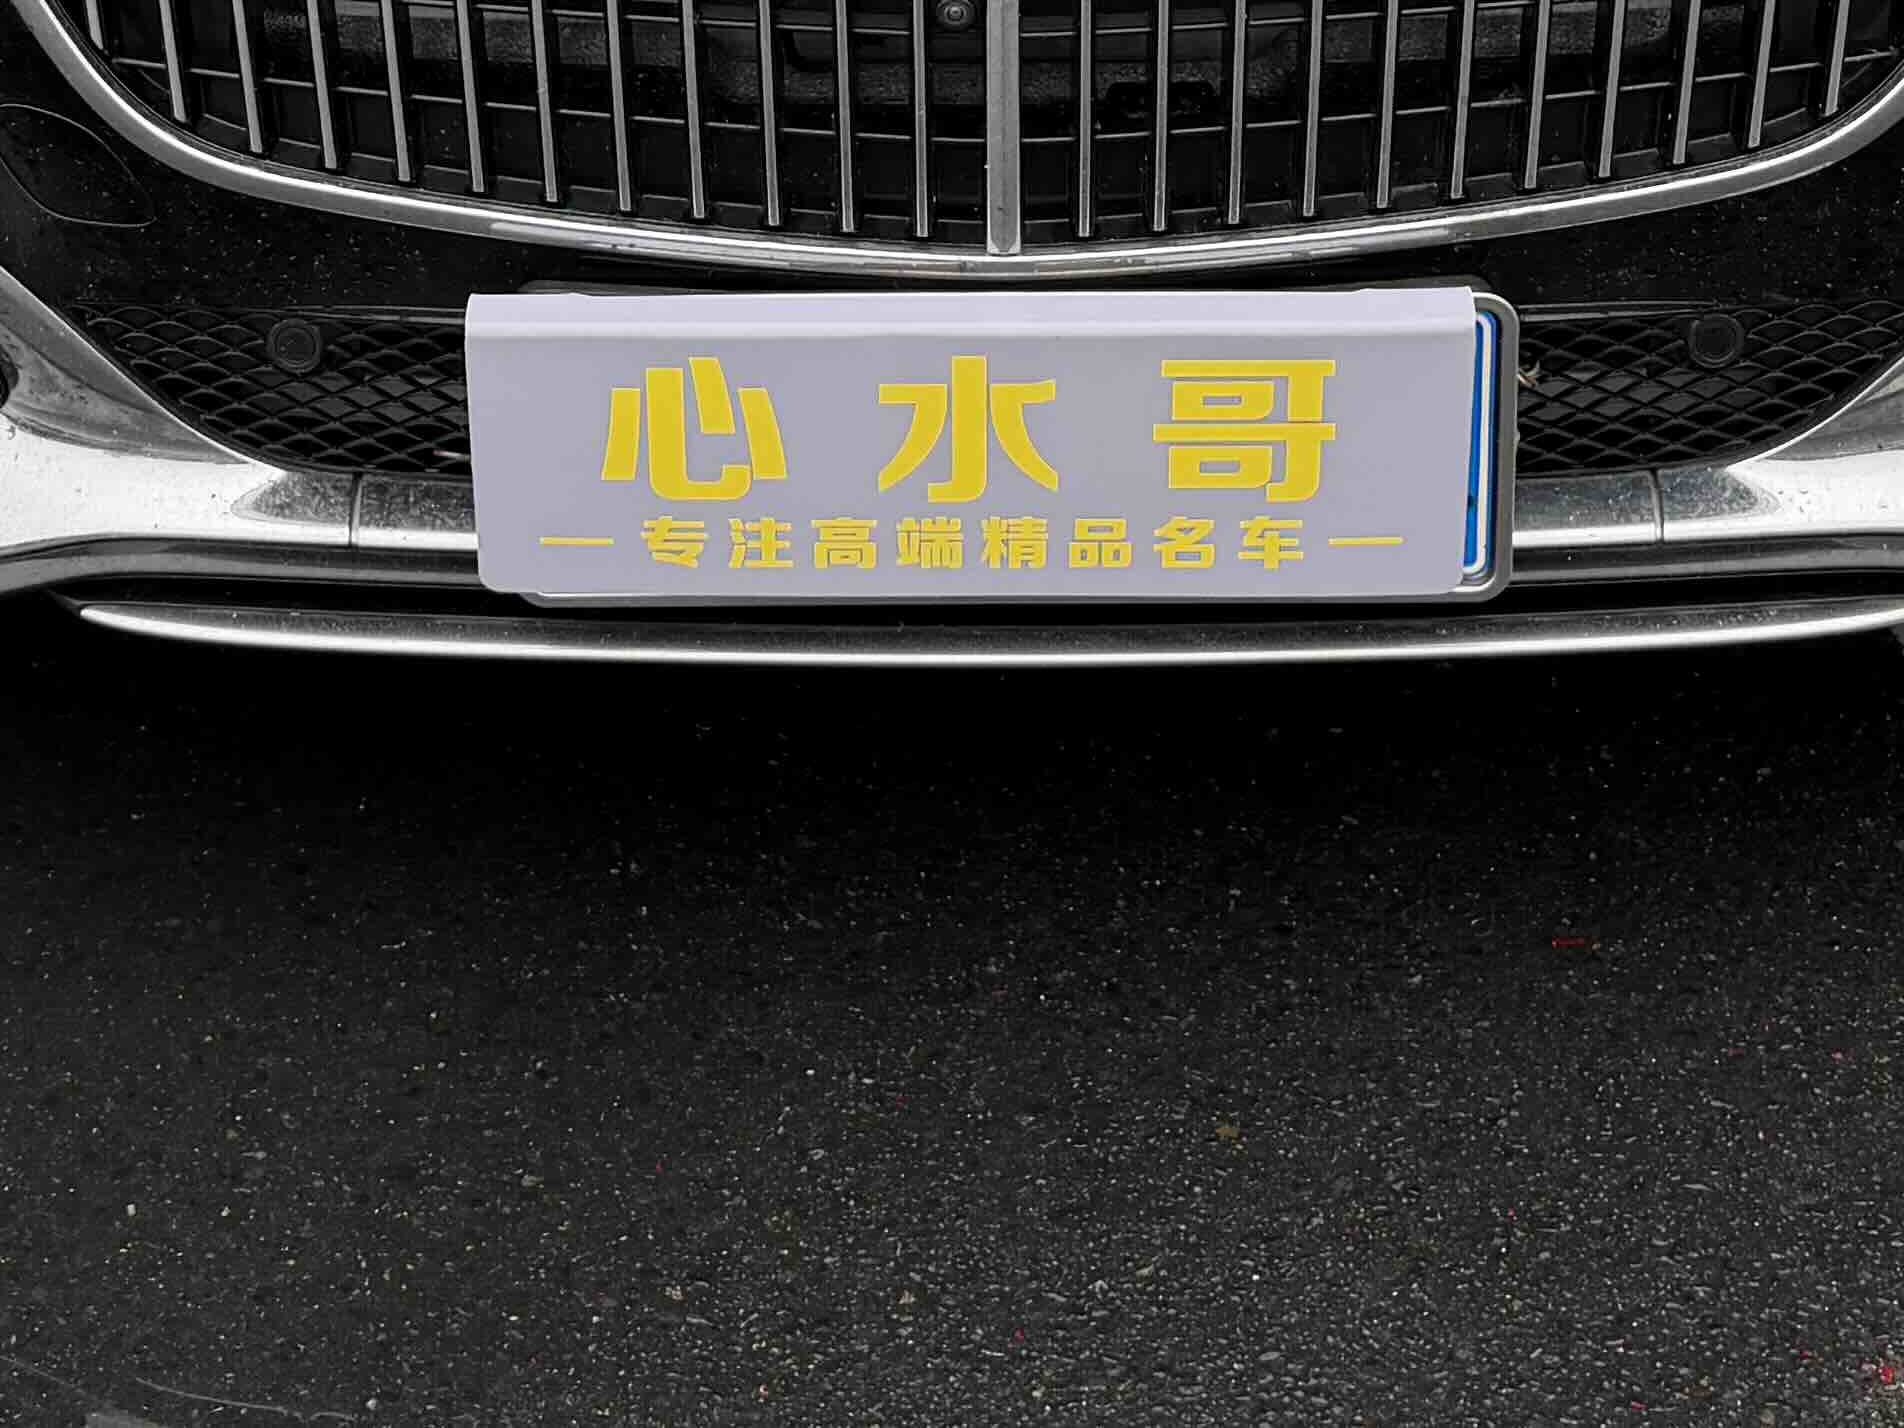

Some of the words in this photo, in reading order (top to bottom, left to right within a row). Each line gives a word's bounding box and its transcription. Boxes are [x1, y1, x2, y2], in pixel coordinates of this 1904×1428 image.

[600, 355, 1337, 502] 心水哥
[640, 516, 1305, 571] 专注高端精品名车
